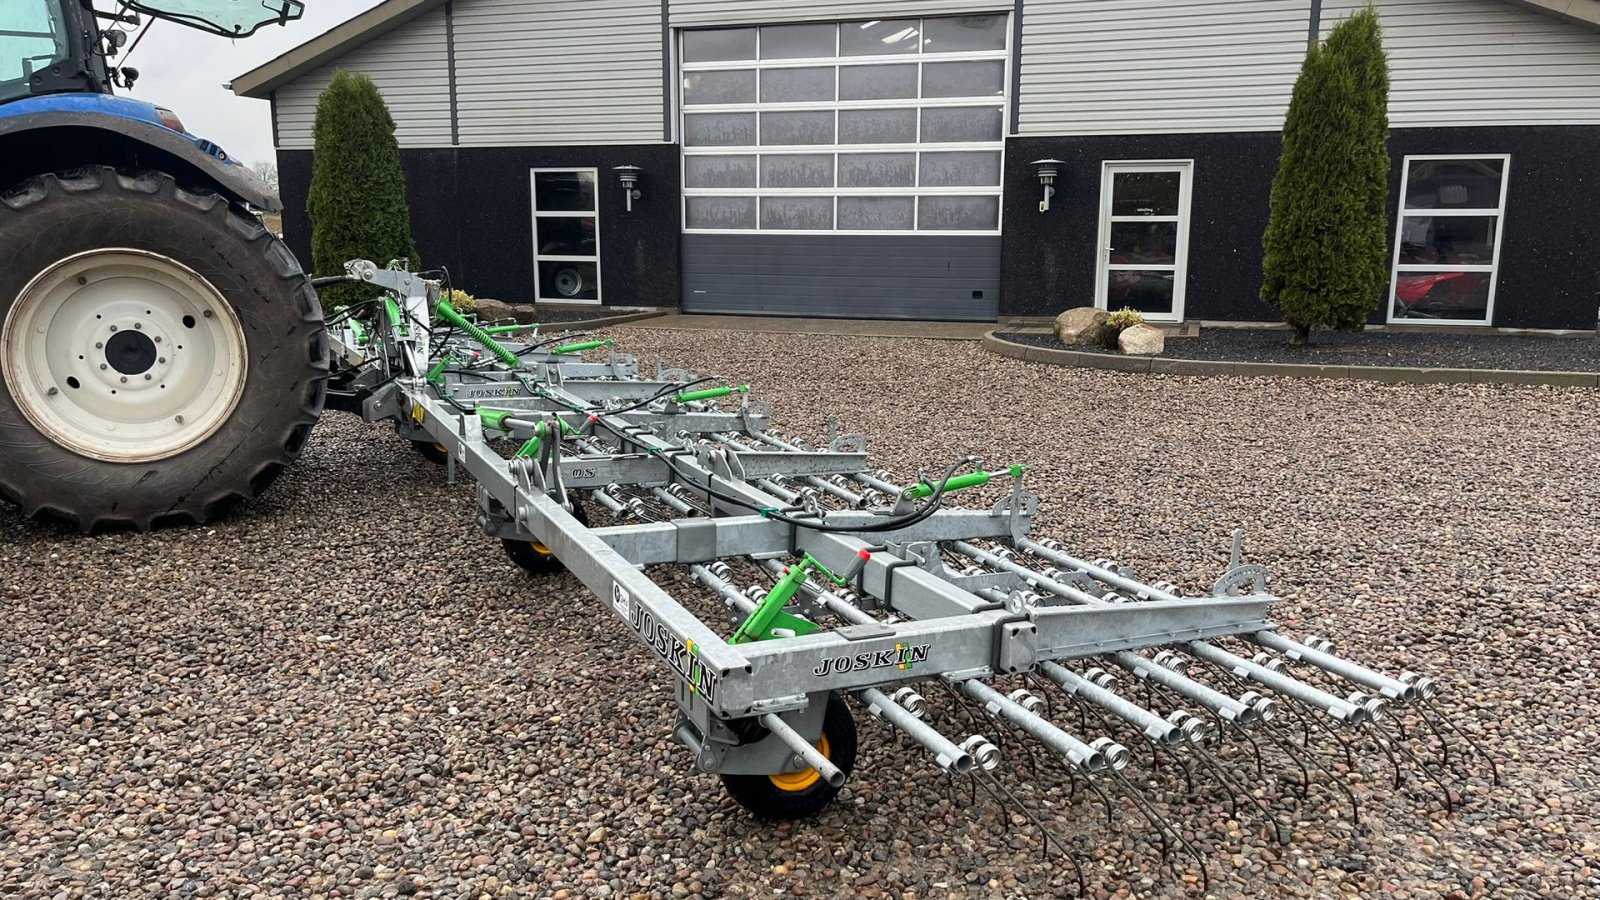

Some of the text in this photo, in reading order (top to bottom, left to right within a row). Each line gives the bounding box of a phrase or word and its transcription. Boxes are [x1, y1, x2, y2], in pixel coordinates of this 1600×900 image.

[466, 387, 521, 398] JOSKIN
[630, 601, 718, 706] JOSKIN
[813, 643, 931, 677] JOSKIN
